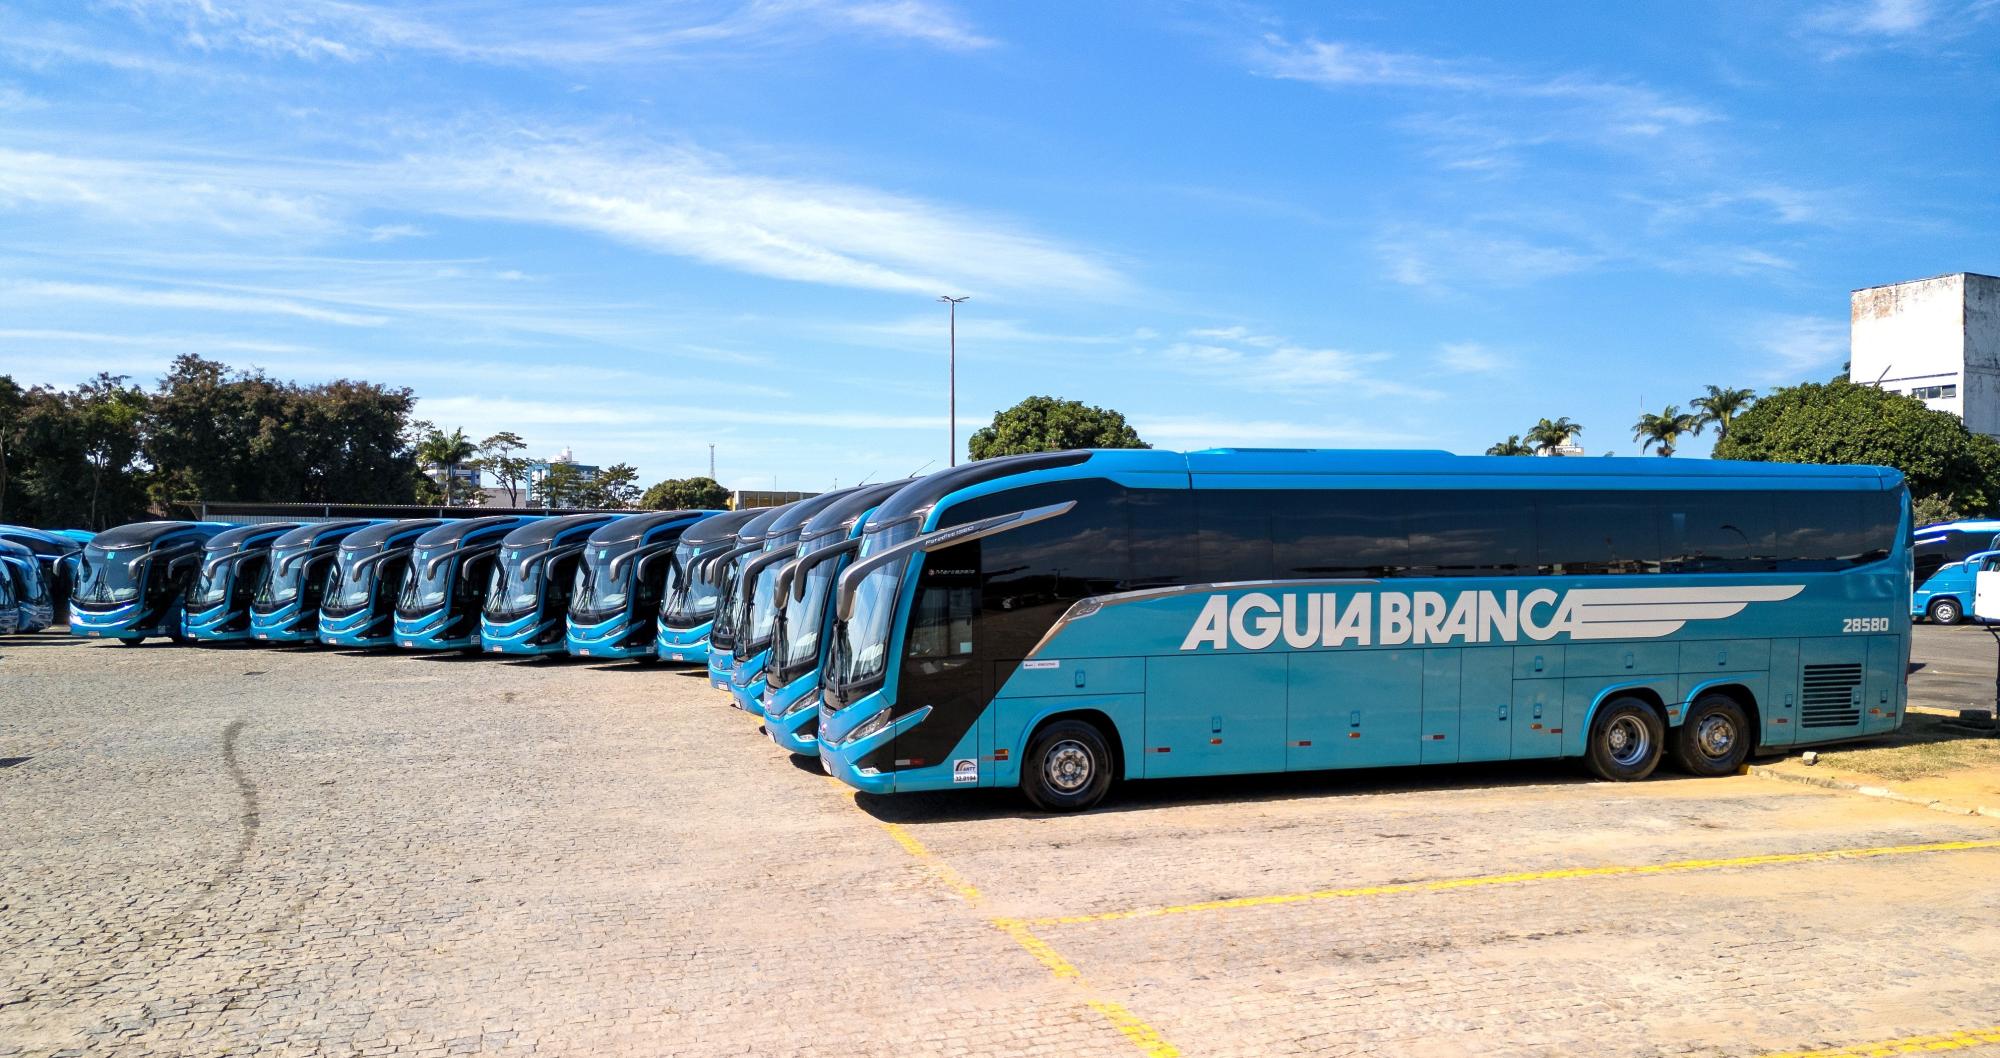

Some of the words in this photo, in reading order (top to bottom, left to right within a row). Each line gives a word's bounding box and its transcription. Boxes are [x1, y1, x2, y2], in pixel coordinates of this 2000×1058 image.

[1179, 592, 1372, 651] AGUIA
[1379, 588, 1583, 645] BRANCA
[1842, 617, 1889, 633] 28580
